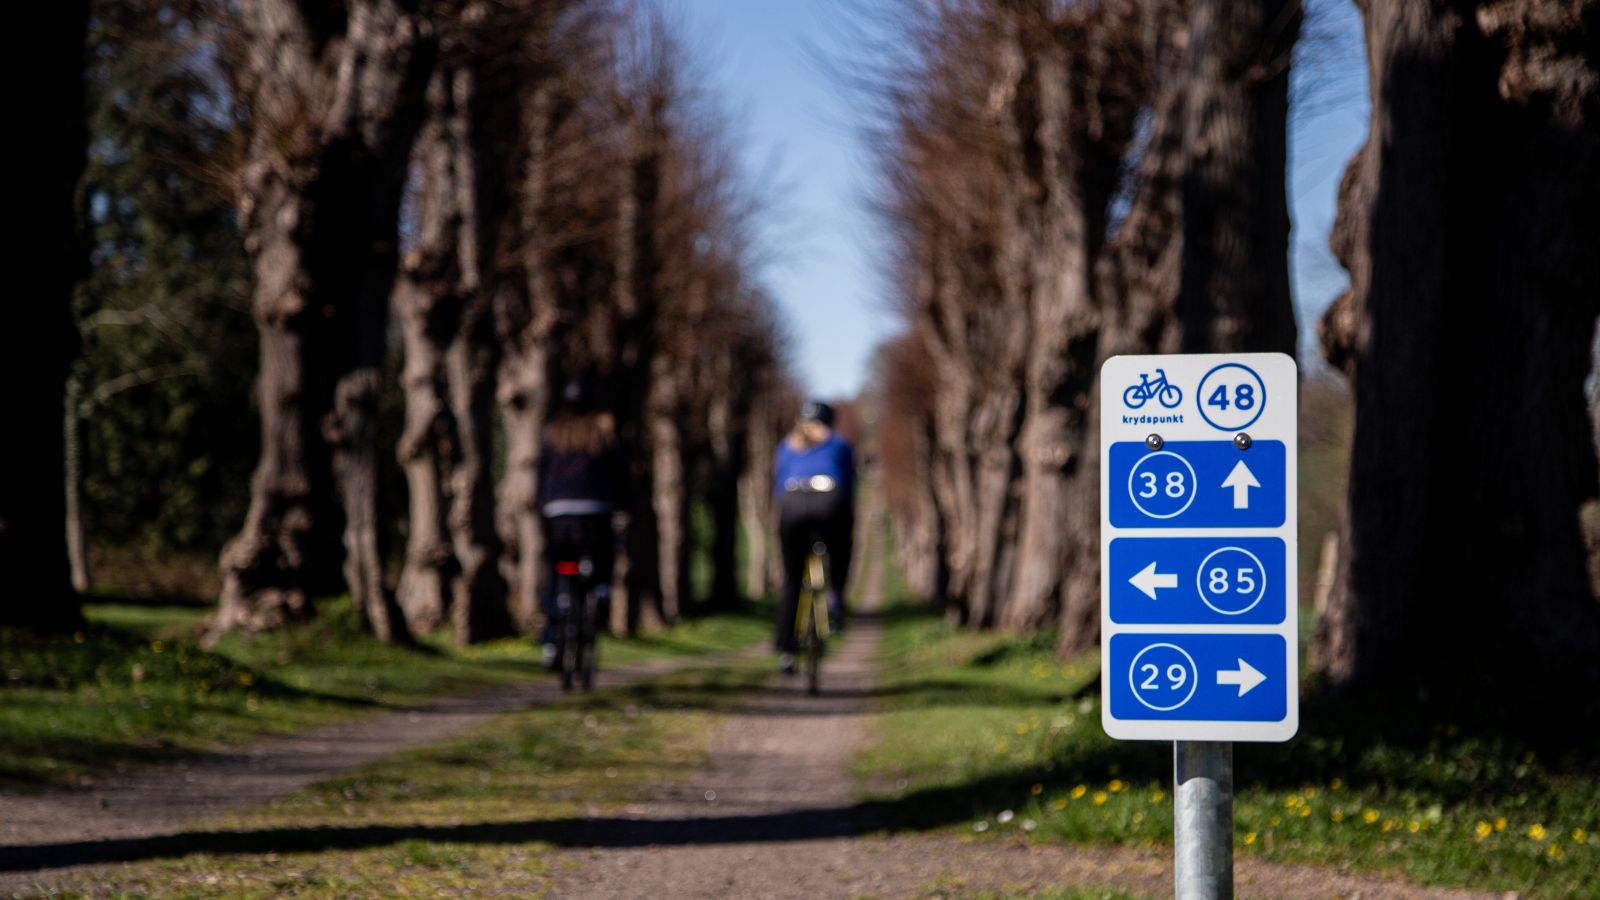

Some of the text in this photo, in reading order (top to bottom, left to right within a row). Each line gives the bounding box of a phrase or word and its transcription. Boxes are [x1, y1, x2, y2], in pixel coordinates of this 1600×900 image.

[1207, 384, 1255, 410] 48
[1122, 414, 1184, 425] krydspunkt
[1139, 472, 1185, 498] 38
[1208, 567, 1255, 594] 85
[1140, 663, 1187, 690] 29
